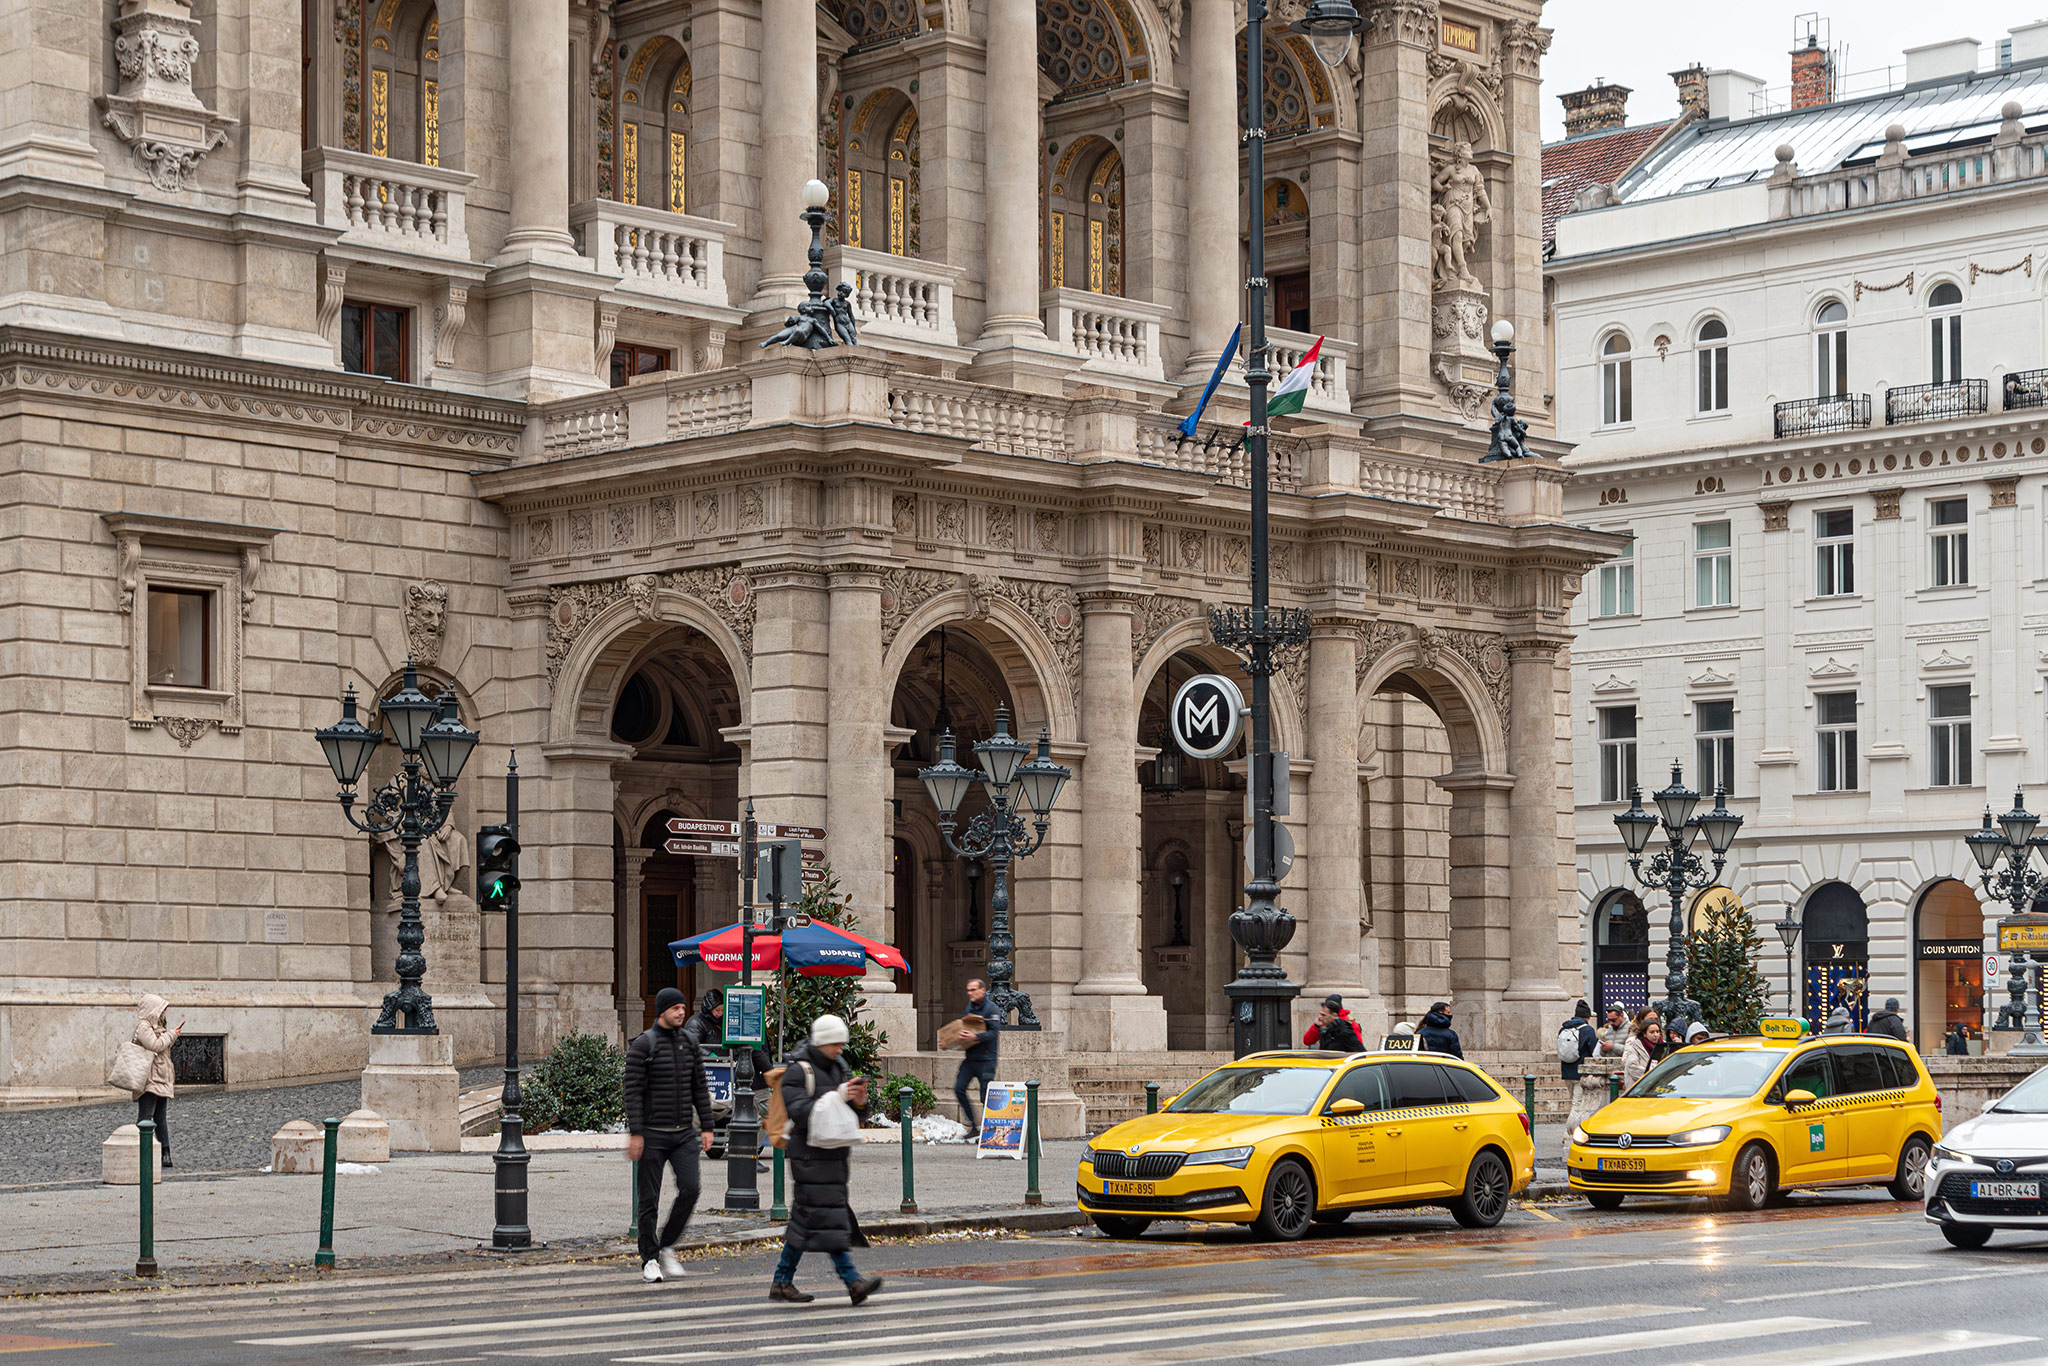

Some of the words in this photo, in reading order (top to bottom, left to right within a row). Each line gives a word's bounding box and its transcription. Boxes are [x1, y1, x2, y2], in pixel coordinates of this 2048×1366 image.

[678, 822, 725, 832] BUDAPESTINFO
[820, 950, 861, 959] BUDAPEST
[1923, 946, 1946, 954] LOUIS
[1946, 946, 1980, 954] VUITTON
[705, 952, 760, 962] INFORMAON
[1988, 962, 1996, 970] 30
[1765, 1024, 1780, 1033] Bolt
[1388, 1040, 1412, 1049] TAXI
[1998, 1184, 2037, 1196] BR-443
